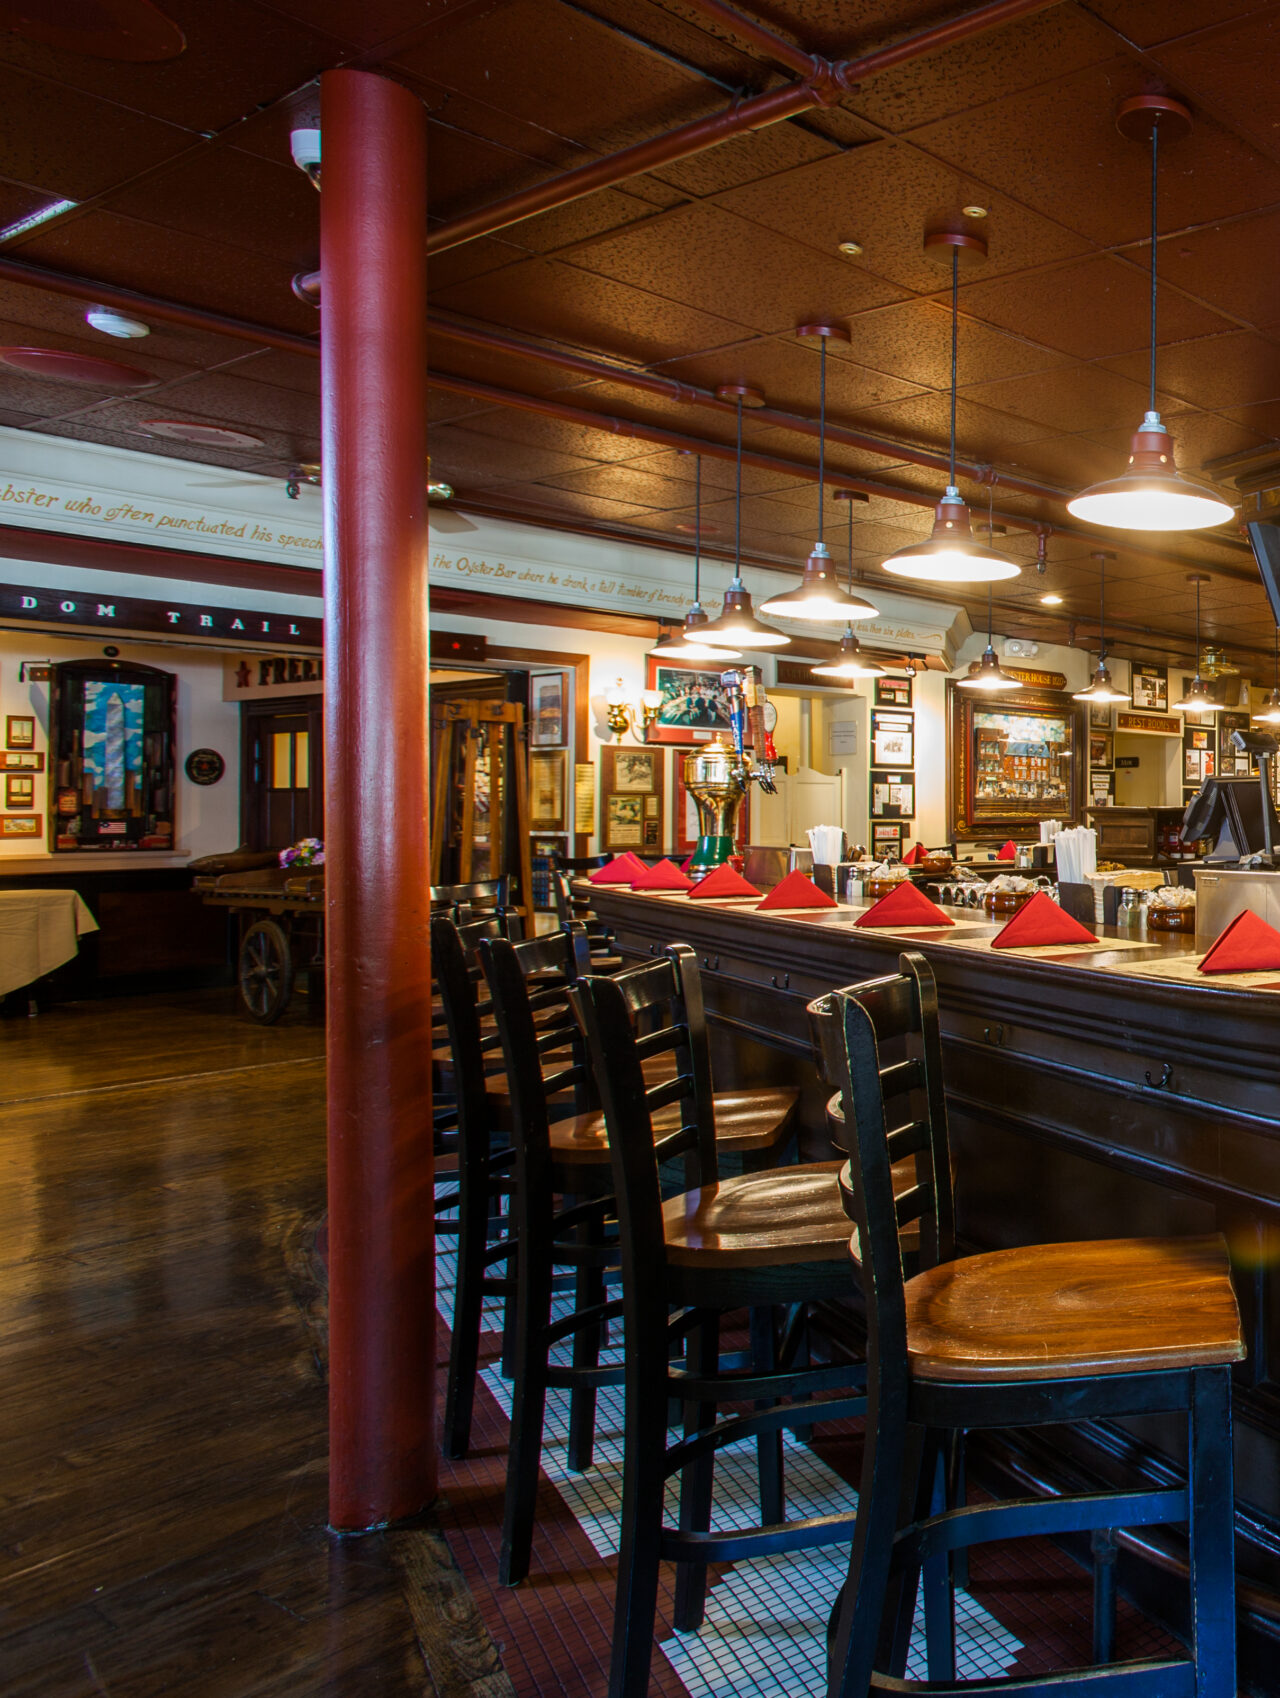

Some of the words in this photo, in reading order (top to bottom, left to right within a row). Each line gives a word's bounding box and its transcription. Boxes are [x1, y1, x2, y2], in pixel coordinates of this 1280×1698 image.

[65, 497, 102, 516] who
[103, 504, 155, 522] often
[155, 514, 245, 538] punctuated
[250, 525, 273, 543] his
[277, 533, 323, 551] speech
[433, 554, 453, 569] the
[456, 557, 495, 576] Oyster
[494, 563, 517, 578] Bar
[20, 596, 116, 617] DOM
[167, 611, 301, 635] TRAIL
[1128, 716, 1146, 729] REST
[1147, 718, 1170, 730] ROOMS
